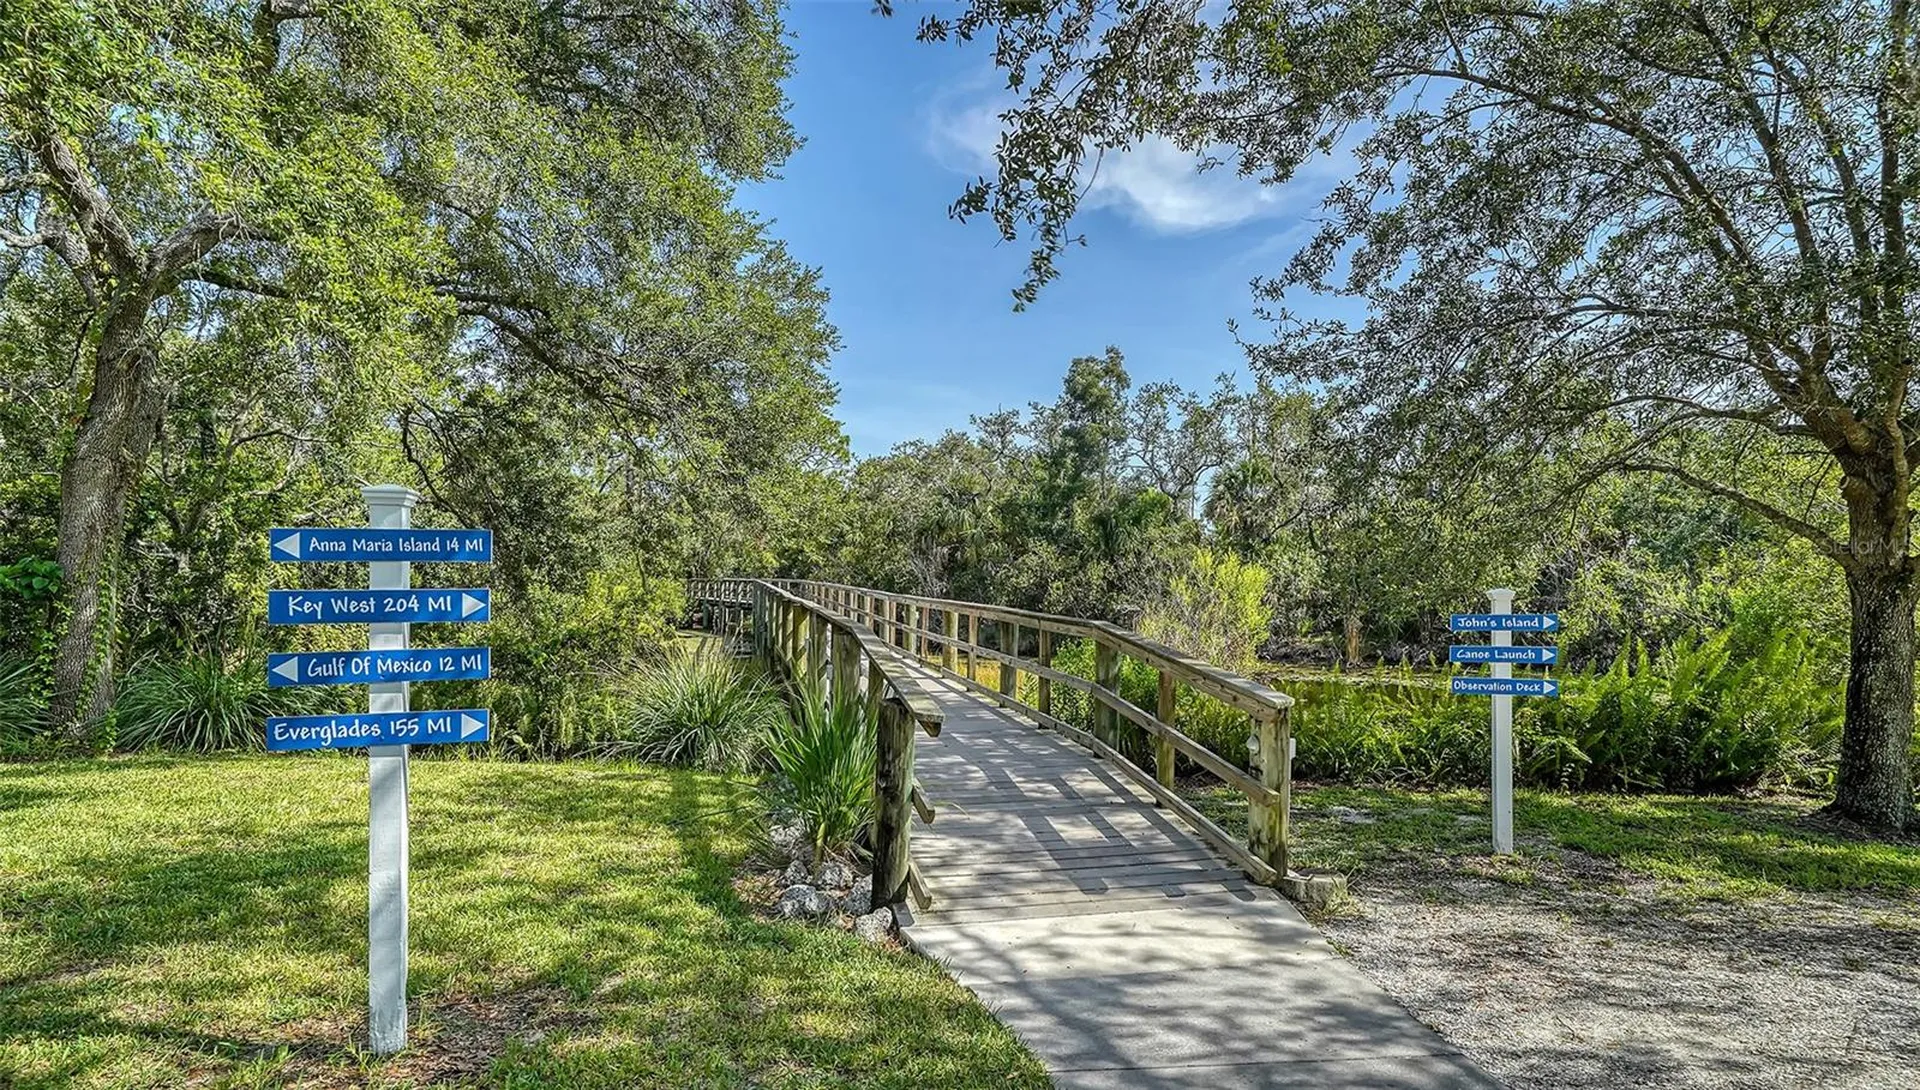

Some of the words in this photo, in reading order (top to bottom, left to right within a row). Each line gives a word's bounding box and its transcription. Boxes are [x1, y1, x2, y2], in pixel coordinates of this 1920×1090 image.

[309, 537, 346, 552] Anna
[352, 538, 392, 552] Maria
[399, 538, 440, 552] Island
[446, 537, 459, 551] 14
[466, 537, 483, 552] MI
[288, 596, 323, 619] Key
[331, 597, 375, 613] West
[384, 597, 419, 612] 204
[428, 596, 452, 611] MI
[1458, 618, 1497, 627] John's
[1502, 618, 1539, 627] Island
[1457, 650, 1490, 658] Canoe
[1495, 650, 1535, 659] Launch
[308, 657, 345, 678] Gulf
[351, 657, 371, 675] Of
[378, 657, 431, 673] Mexico
[439, 657, 455, 671] 12
[462, 654, 482, 670] MI
[1454, 681, 1512, 691] Observation
[1516, 682, 1541, 692] Deck
[273, 720, 381, 745] Everglades
[391, 718, 419, 736] 155
[428, 717, 451, 733] MI
